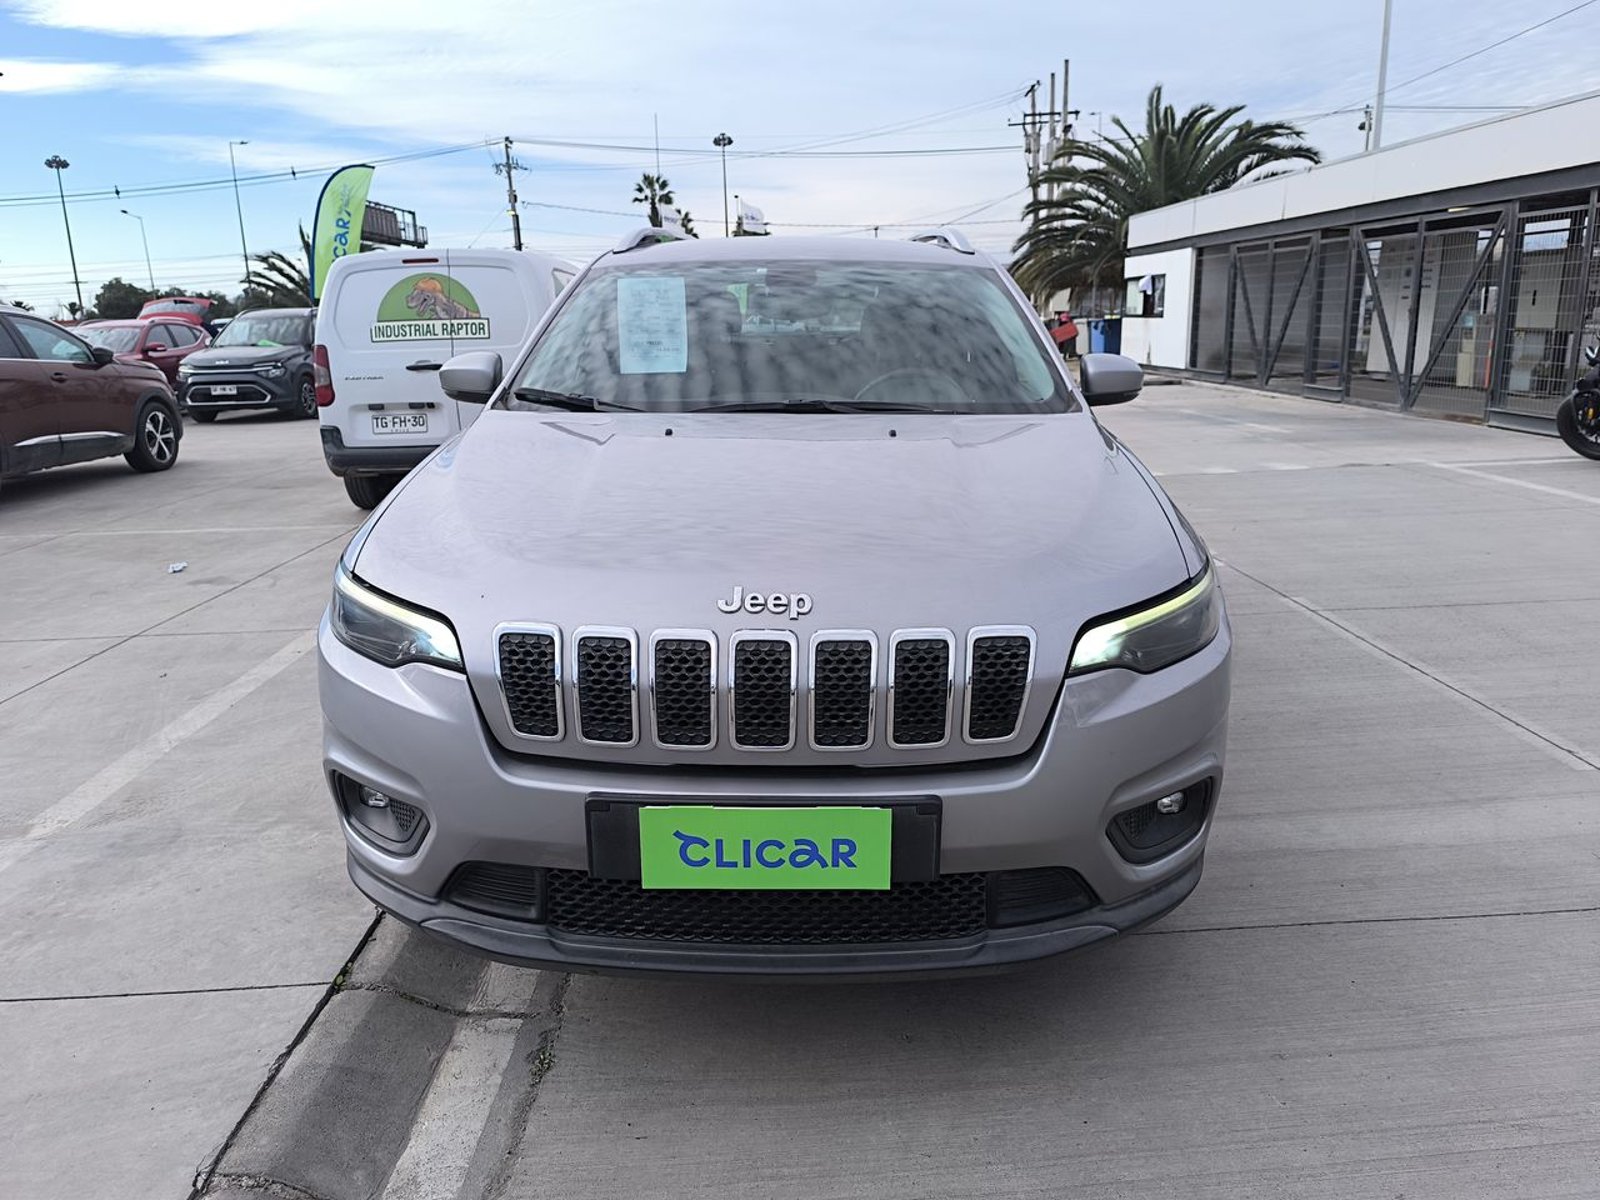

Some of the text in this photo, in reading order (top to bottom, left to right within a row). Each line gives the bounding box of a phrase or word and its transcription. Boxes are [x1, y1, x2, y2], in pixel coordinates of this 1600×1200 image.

[374, 322, 486, 338] INDUSTRIAL RAPTOR
[716, 586, 813, 620] Jeep
